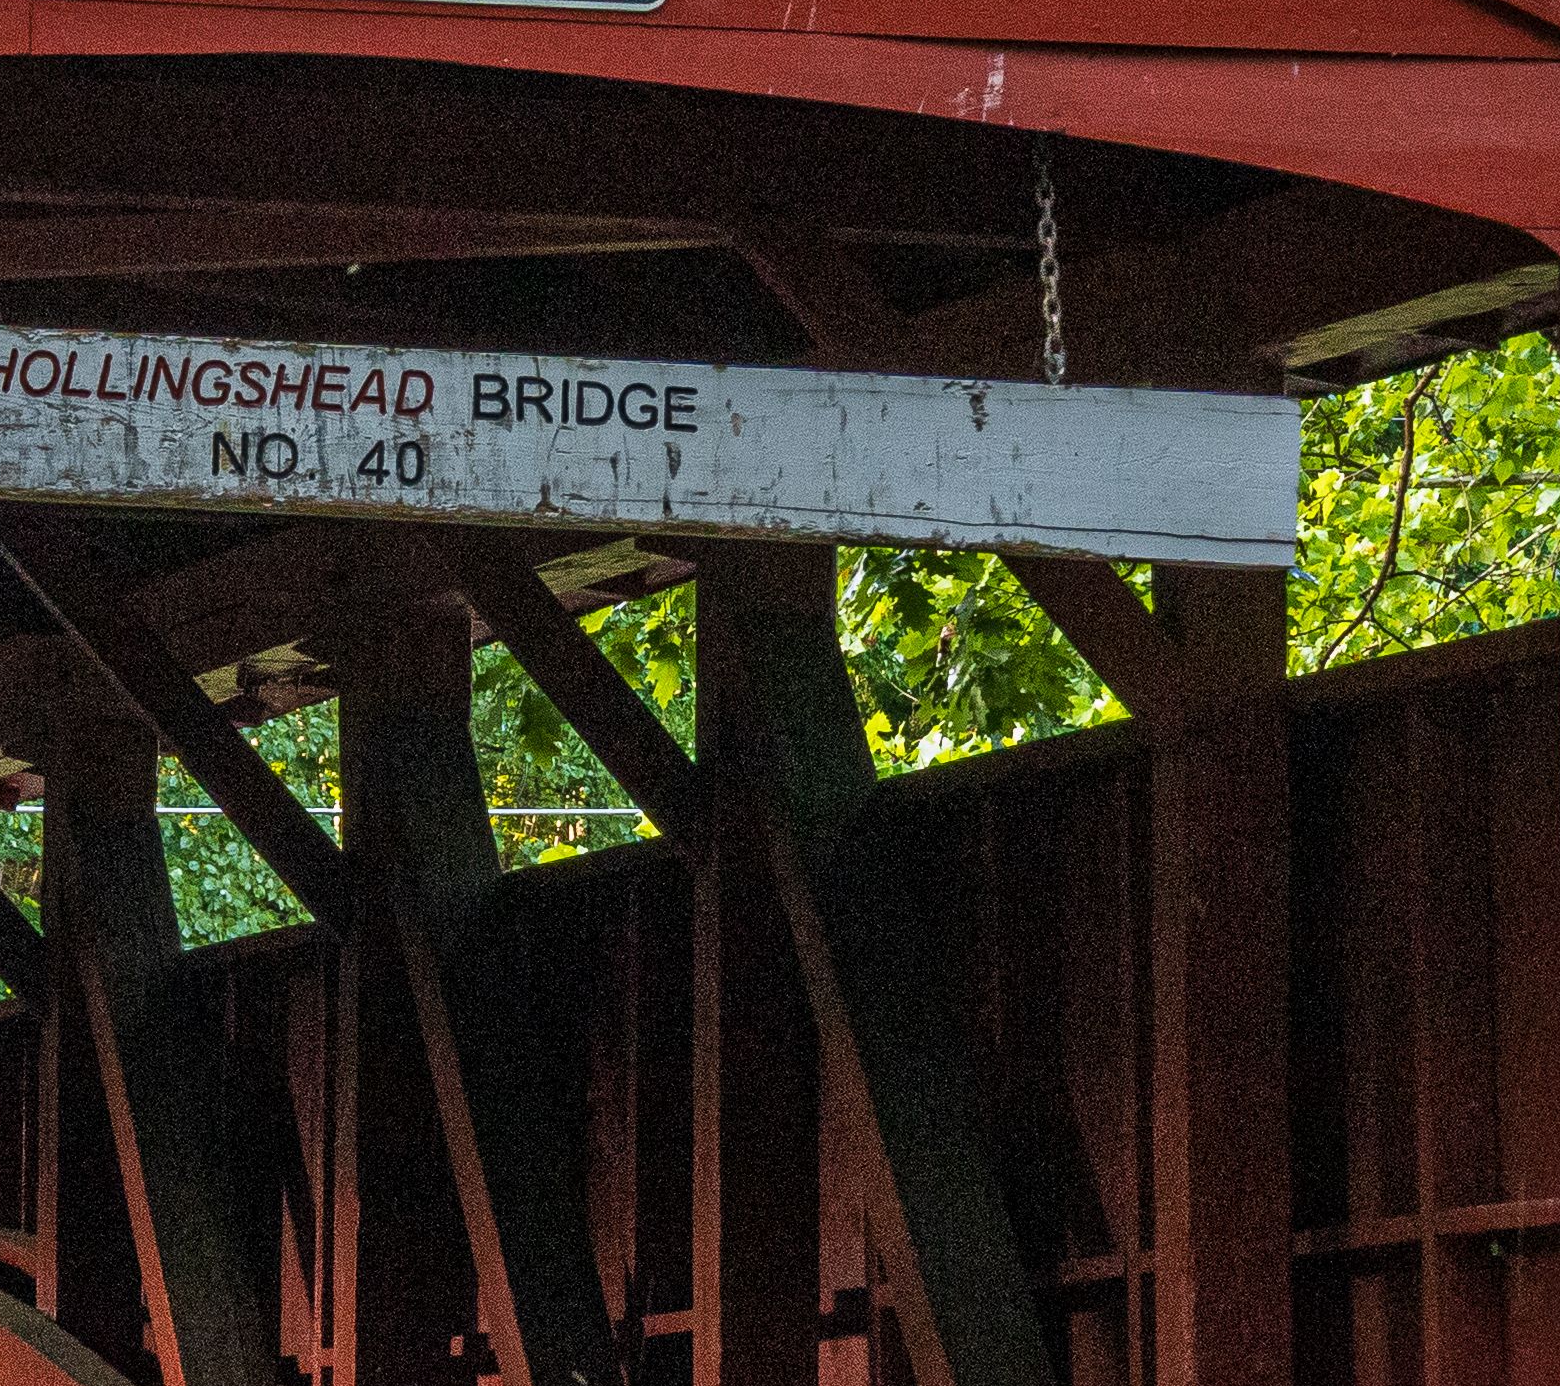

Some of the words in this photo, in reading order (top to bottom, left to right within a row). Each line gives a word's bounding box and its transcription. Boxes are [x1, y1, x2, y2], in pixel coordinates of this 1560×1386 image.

[471, 373, 700, 433] BRIDGE
[211, 431, 317, 481] NO.
[356, 438, 426, 487] 40
